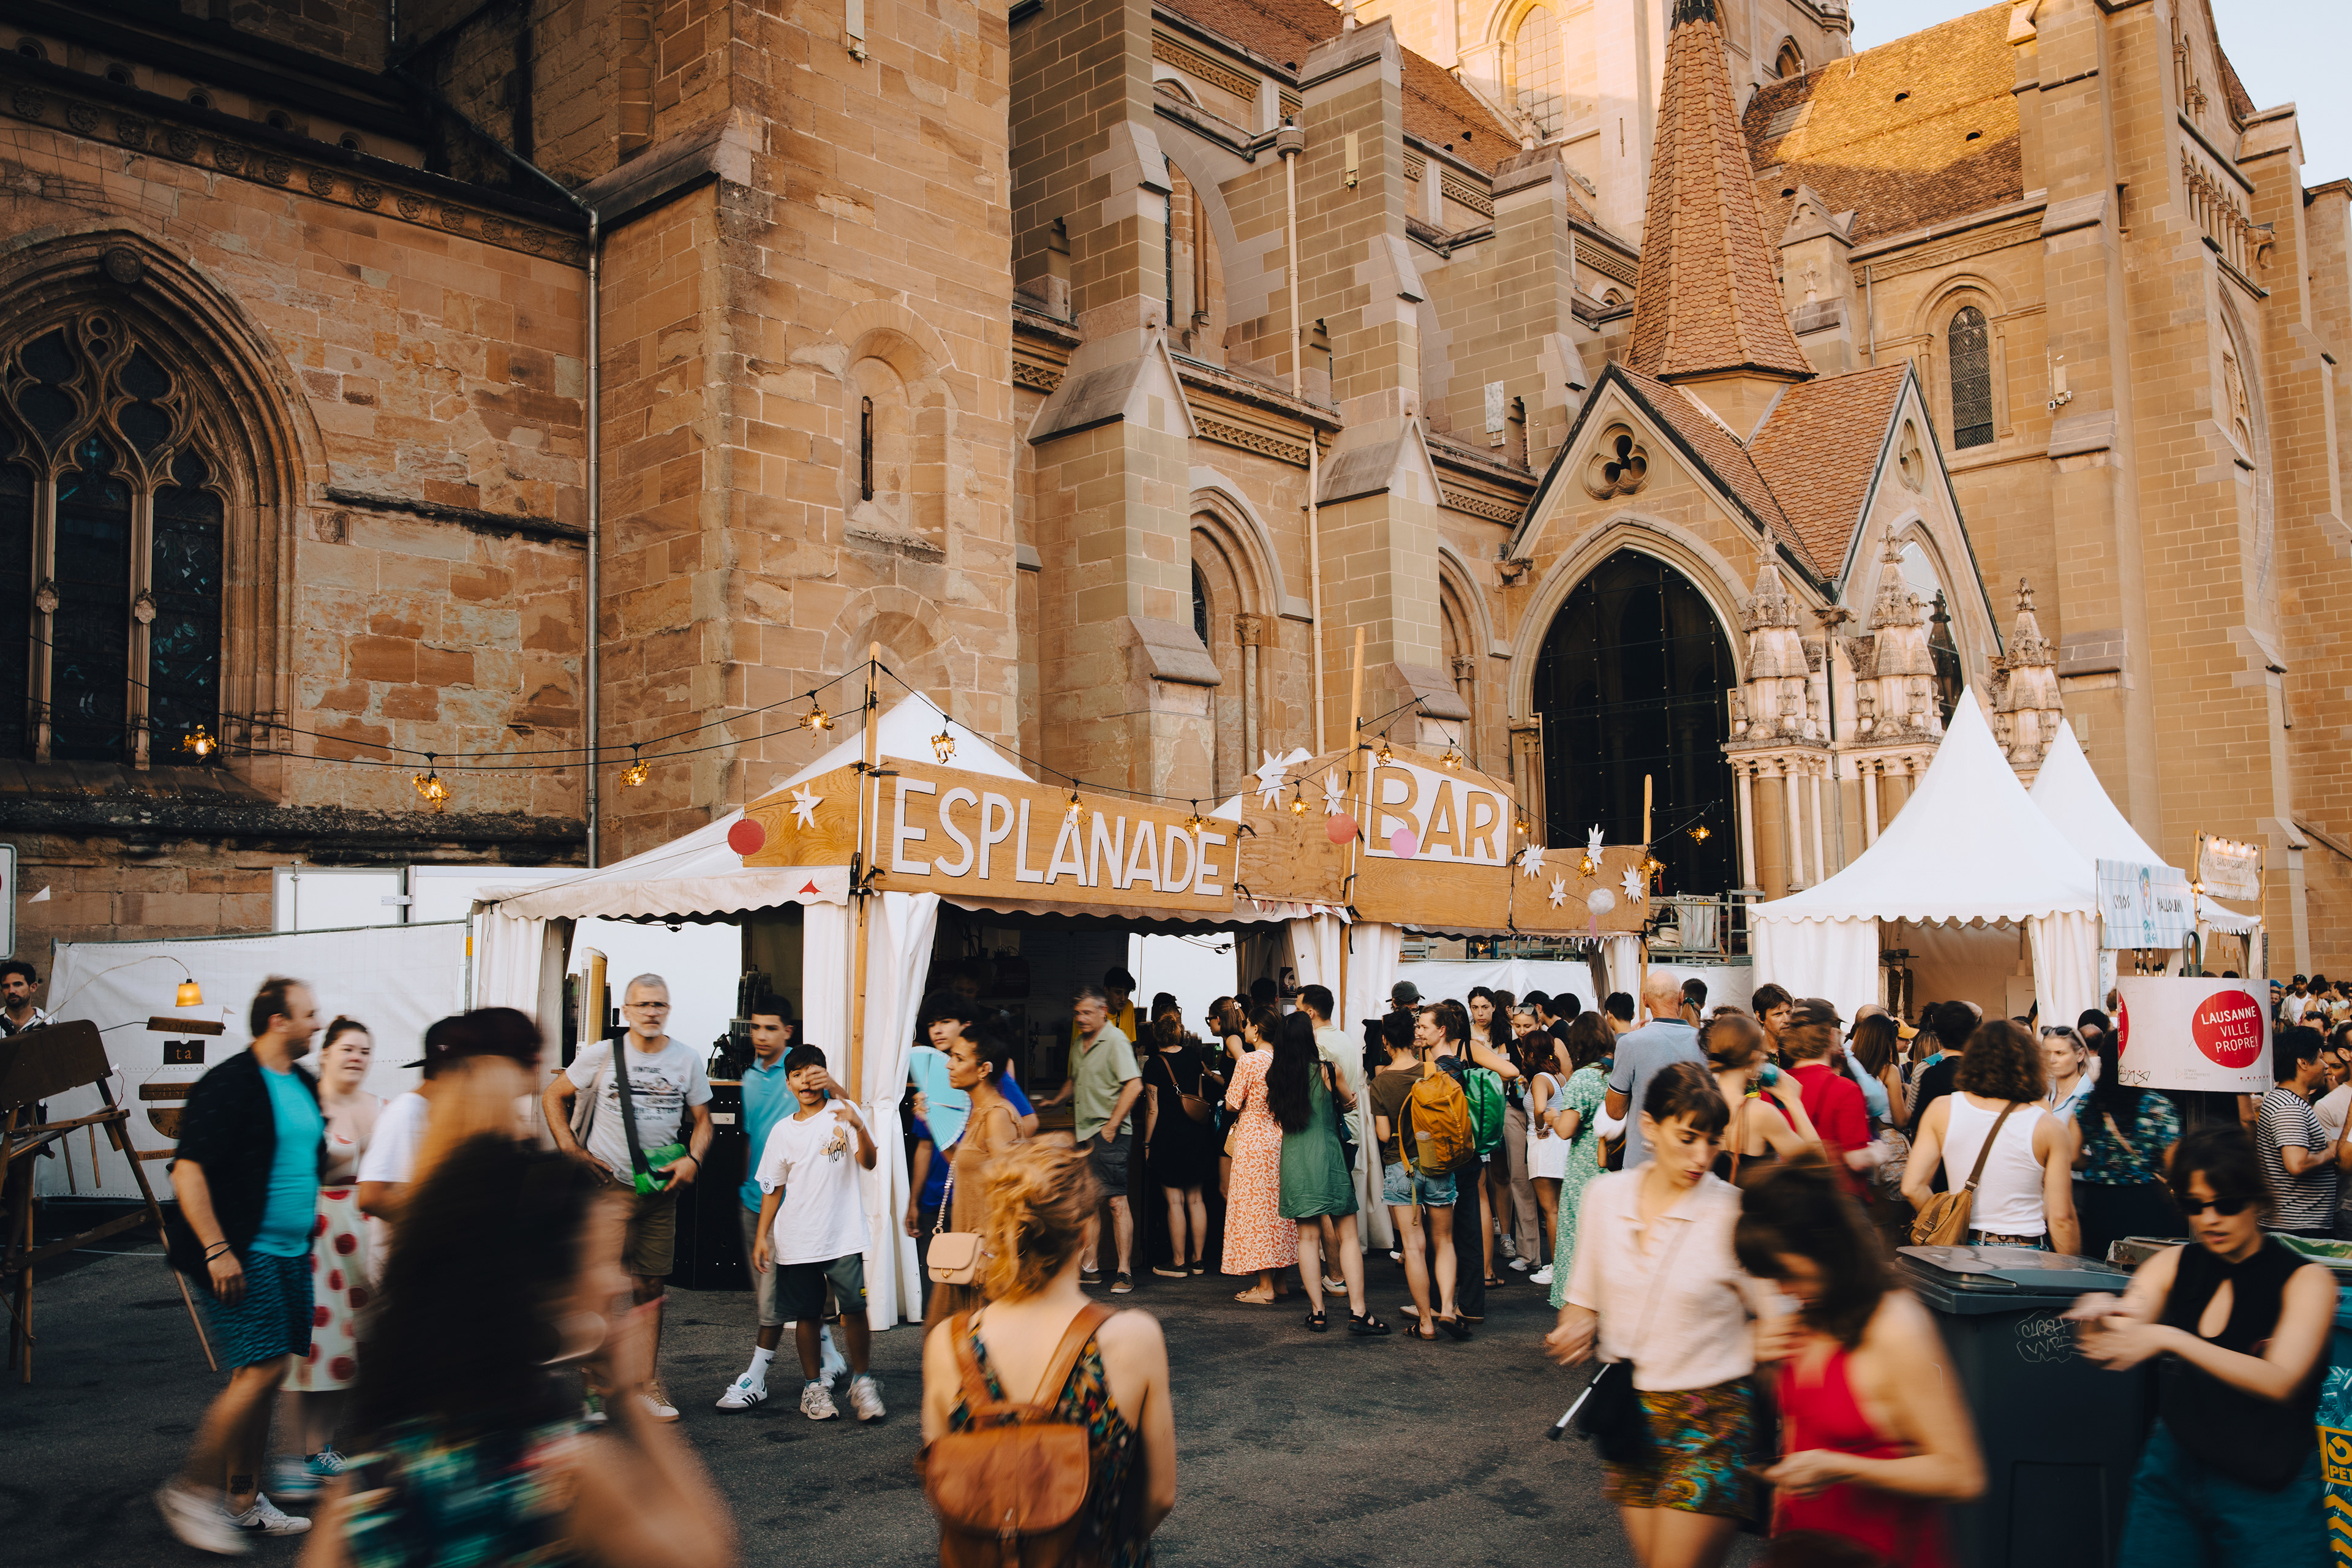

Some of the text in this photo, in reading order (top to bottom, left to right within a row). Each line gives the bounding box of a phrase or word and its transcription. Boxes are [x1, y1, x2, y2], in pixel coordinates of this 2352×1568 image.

[1370, 766, 1501, 860] BAR
[892, 777, 1227, 896] ESPLANADE
[2113, 895, 2184, 913] GYROS HALLOUMI
[2201, 1005, 2256, 1025] LAUSANNE
[168, 1022, 200, 1031] Offre
[2220, 1022, 2250, 1037] VILLE
[2215, 1035, 2258, 1053] PROPRE!
[176, 1048, 192, 1060] ta
